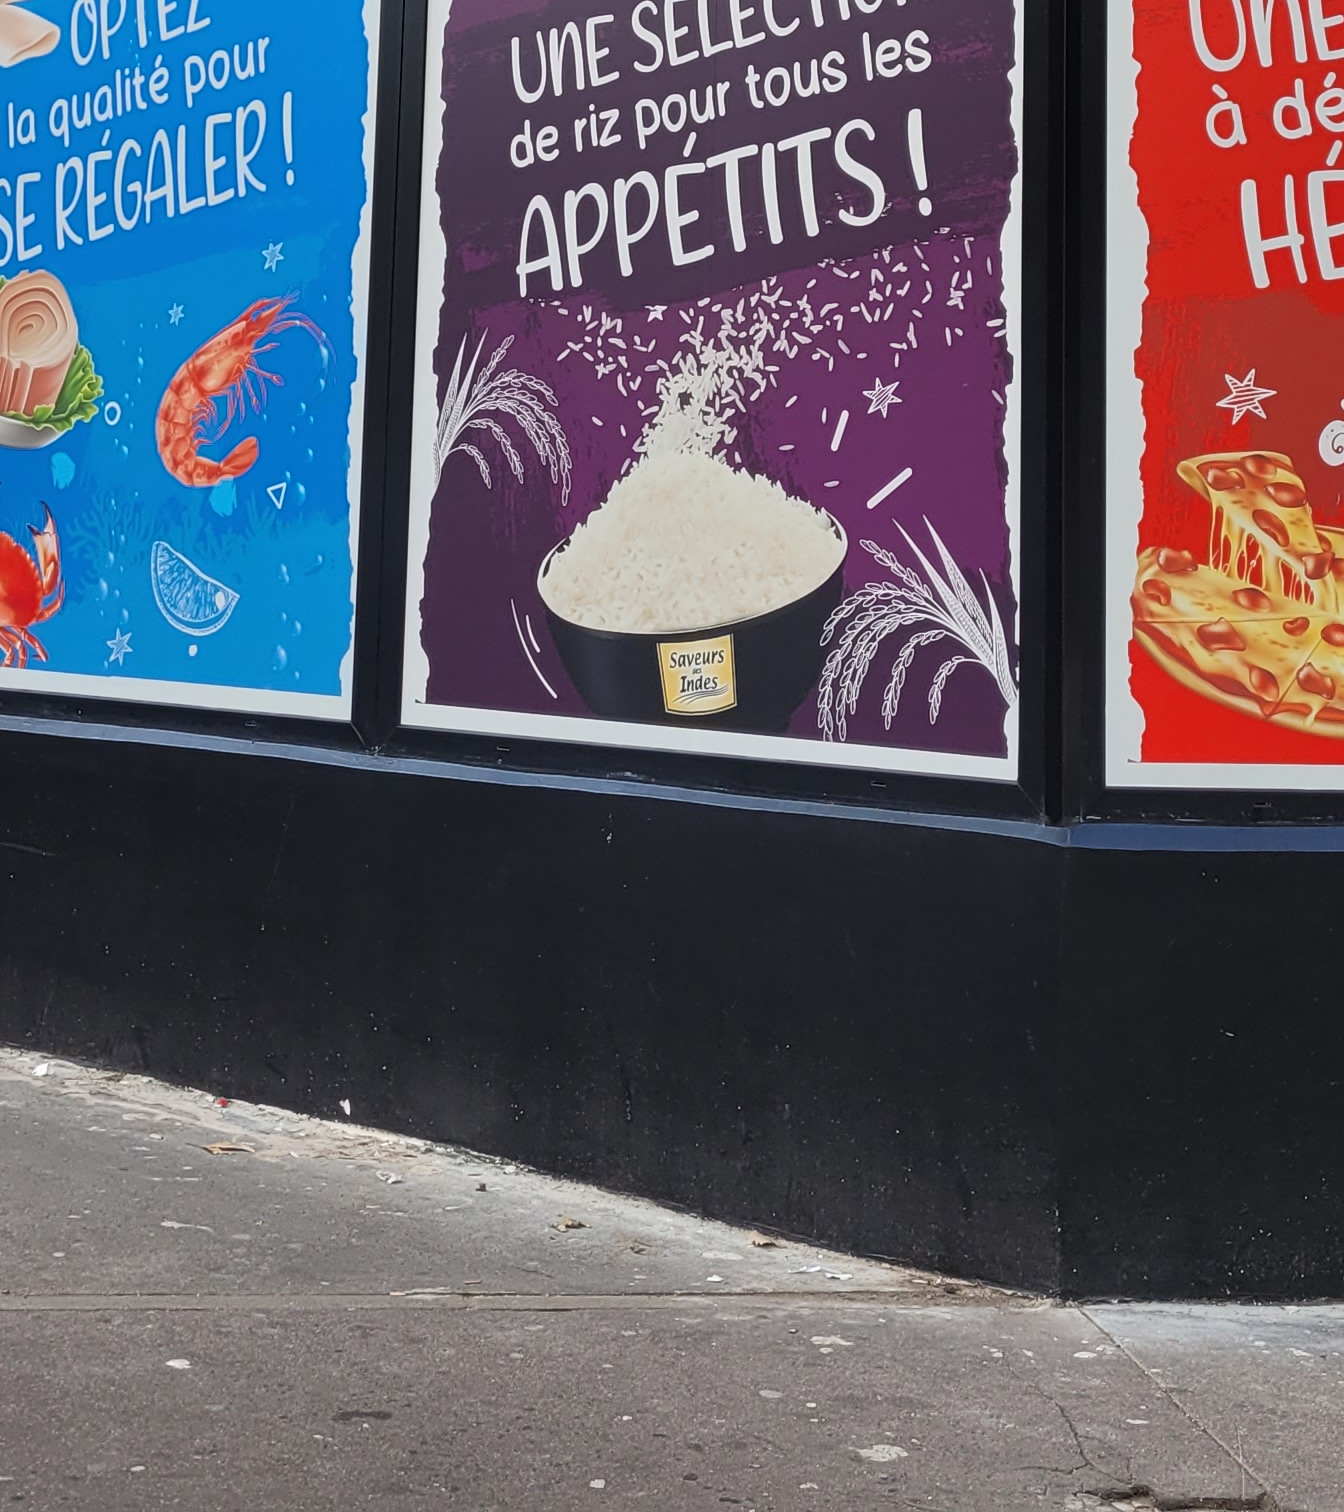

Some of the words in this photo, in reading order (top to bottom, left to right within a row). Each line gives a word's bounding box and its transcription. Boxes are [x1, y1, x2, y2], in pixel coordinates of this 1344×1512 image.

[9, 104, 35, 147] la
[52, 56, 169, 147] qualité
[185, 38, 269, 107] pour
[510, 120, 559, 168] de
[575, 104, 621, 152] riz
[635, 81, 730, 149] pour
[745, 51, 847, 108] tous
[863, 30, 931, 81] les
[511, 14, 619, 103] UNE
[1206, 84, 1247, 148] à
[56, 102, 267, 250] RÉGALER
[517, 118, 886, 297] APPÉTITS
[669, 649, 724, 669] Saveurs
[680, 675, 718, 693] Indes
